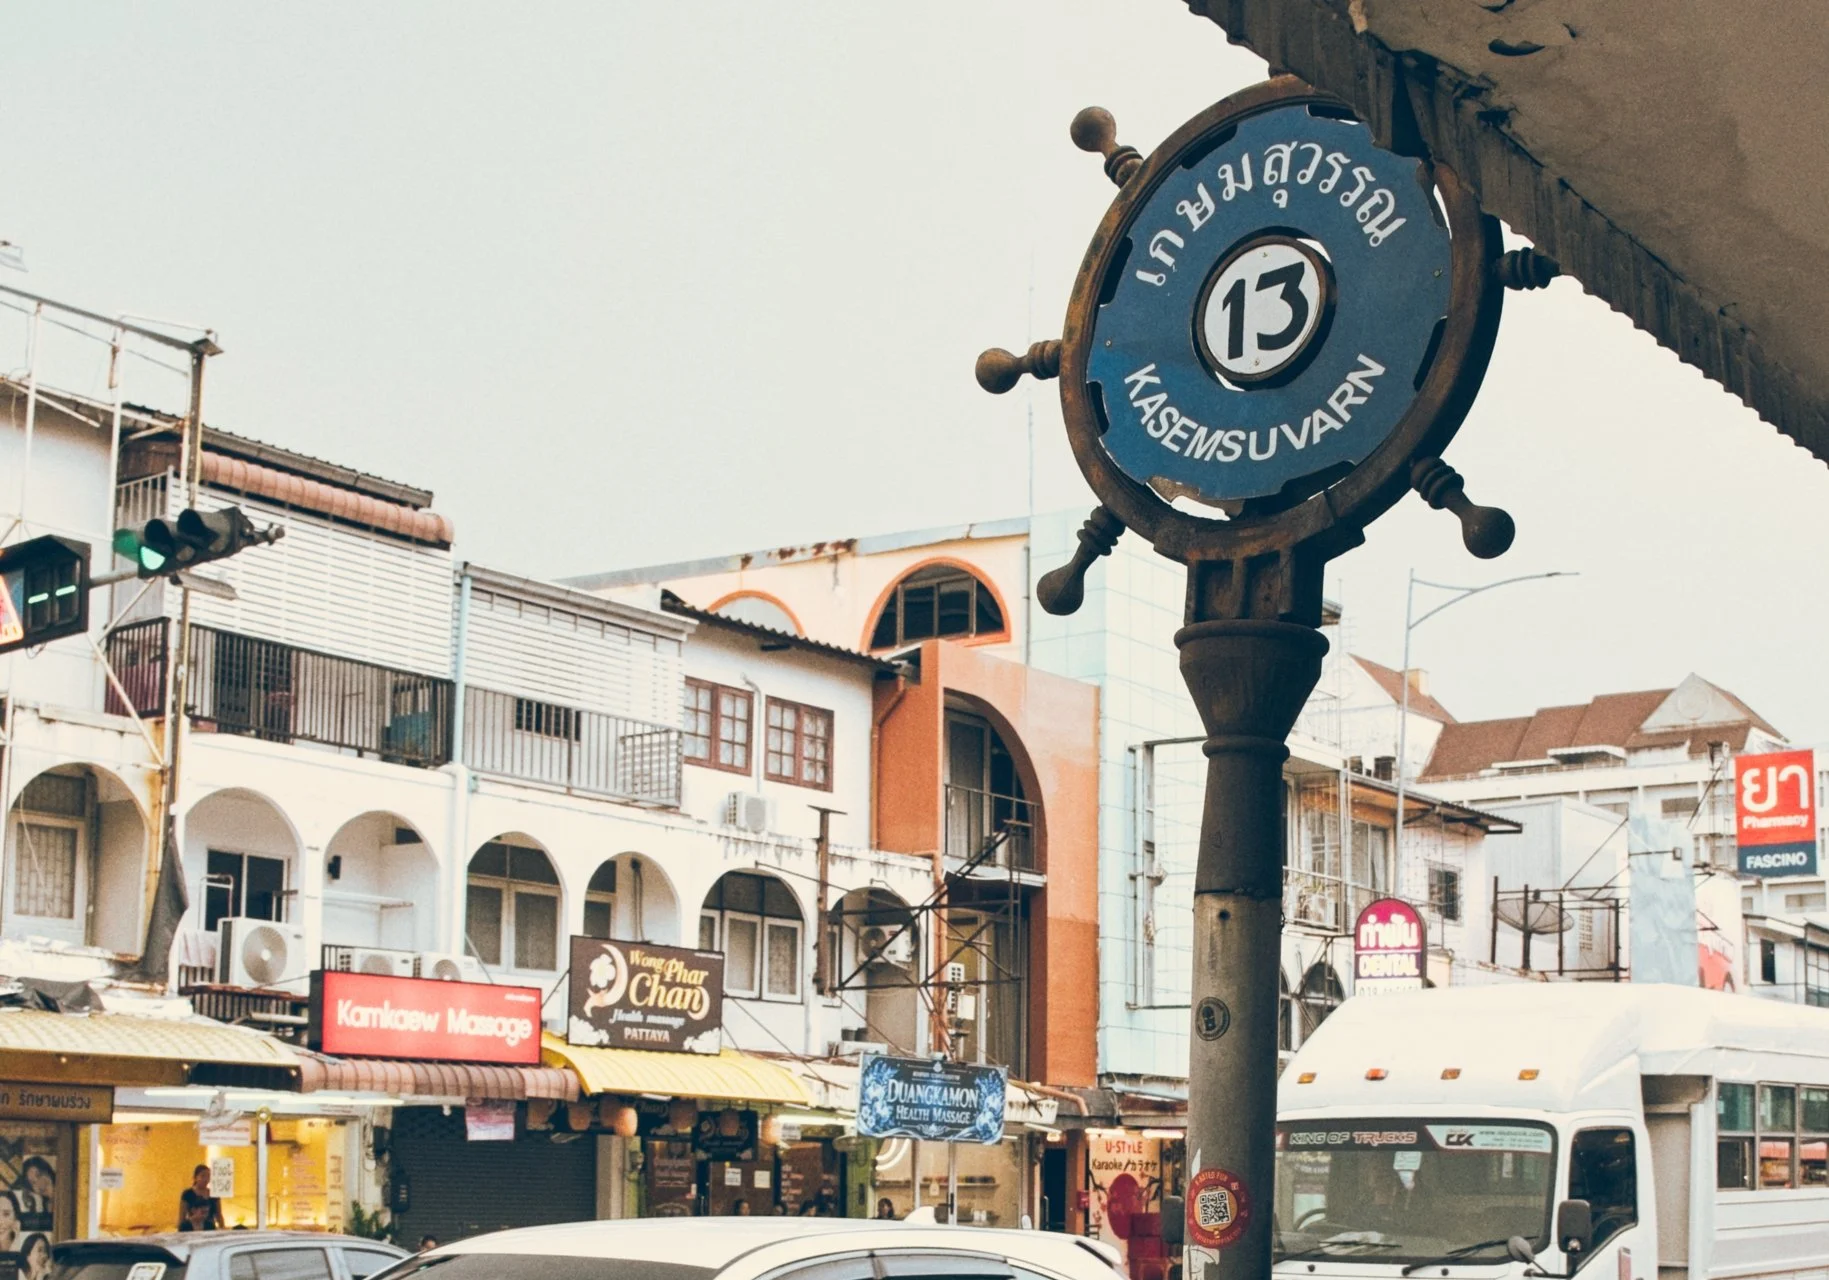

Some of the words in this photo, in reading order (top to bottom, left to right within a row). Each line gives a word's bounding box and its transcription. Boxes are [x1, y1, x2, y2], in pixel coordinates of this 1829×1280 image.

[1136, 141, 1407, 286] เกษมสุวรรณ
[1222, 261, 1310, 361] 13
[1123, 354, 1386, 463] KASEMSUVARN
[1741, 764, 1809, 813] ยา
[1745, 851, 1807, 869] FASCINO
[629, 950, 665, 973] Wong
[663, 957, 709, 985] Phar
[1359, 954, 1419, 977] DENTAL
[628, 972, 702, 1012] Chan
[337, 999, 440, 1033] Kamkaew
[447, 1008, 533, 1047] Massage
[623, 1026, 671, 1043] PATTAYA
[887, 1078, 979, 1108] DUANGKAMON
[896, 1105, 929, 1121] HEALTH
[932, 1108, 972, 1124] MASSAGE
[1105, 1140, 1143, 1154] U-STYLE
[1289, 1132, 1327, 1145] KING
[1327, 1132, 1350, 1145] OF
[1352, 1131, 1417, 1147] TRUCKS
[1092, 1158, 1122, 1170] Karaoke
